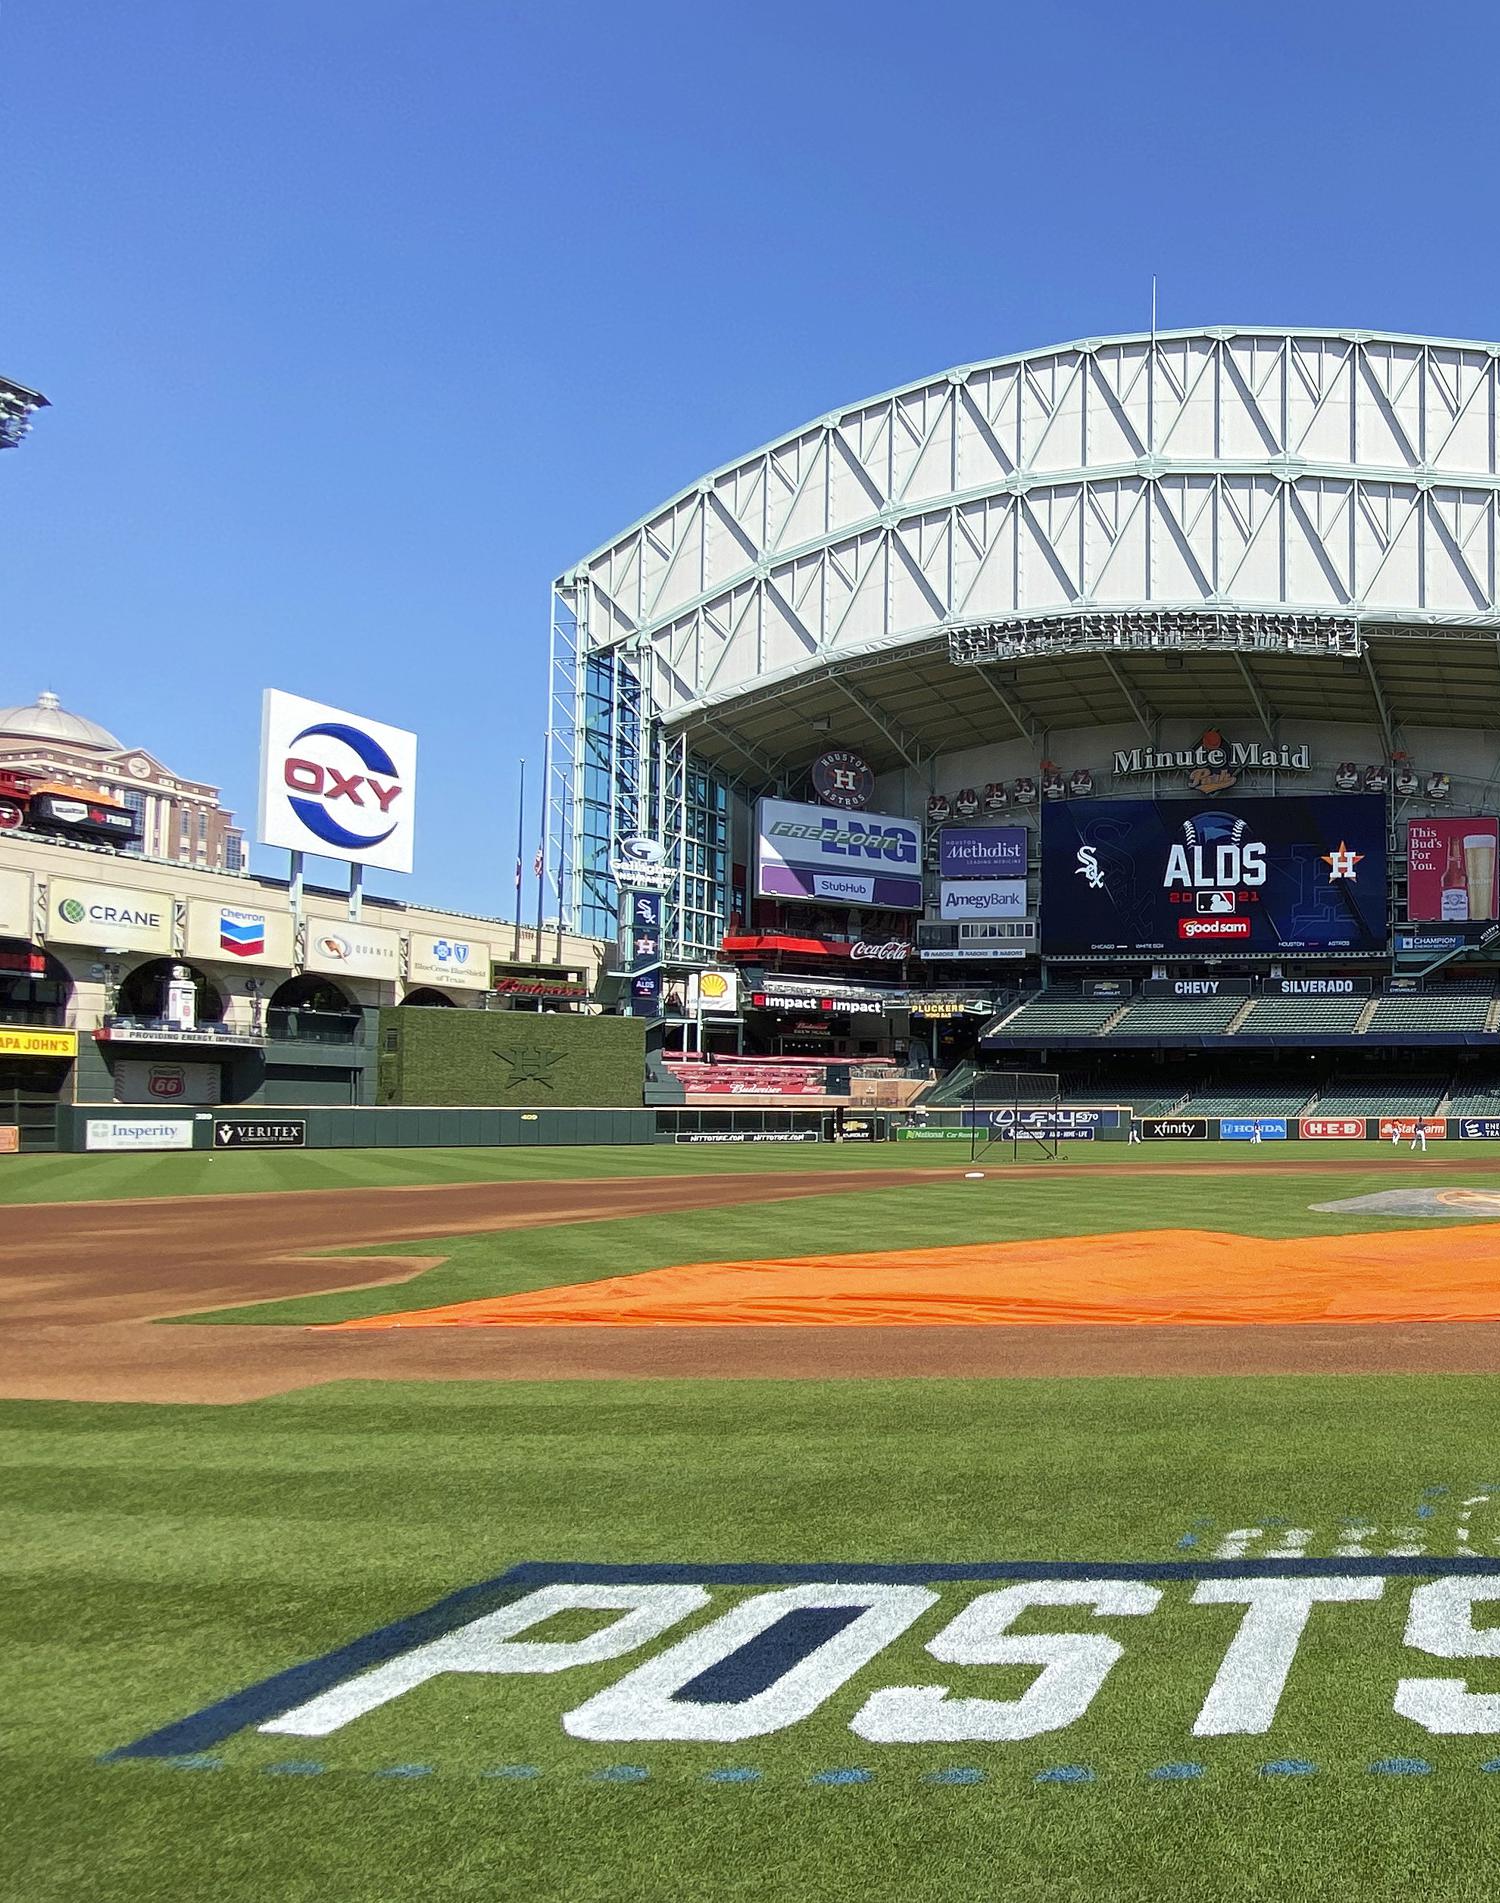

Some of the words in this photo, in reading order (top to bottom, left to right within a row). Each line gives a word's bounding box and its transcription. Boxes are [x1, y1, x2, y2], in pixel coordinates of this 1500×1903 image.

[821, 753, 868, 773] HOUSTON
[1113, 746, 1224, 773] Minute
[1231, 743, 1311, 769] Maid
[284, 757, 402, 812] OXY
[834, 769, 856, 791] H
[823, 789, 865, 805] ASTROS
[773, 823, 898, 849] FREEPORT
[1410, 828, 1437, 838] This
[822, 818, 917, 864] LNG
[1411, 839, 1442, 849] Bud's
[946, 842, 1021, 858] Methodist
[1411, 850, 1430, 860] For
[1163, 842, 1266, 887] ALDS
[1329, 852, 1356, 878] H
[1410, 861, 1436, 871] You.
[821, 880, 866, 894] StubHub
[945, 892, 1019, 908] AmegyBank
[1170, 892, 1193, 902] 20
[1238, 891, 1259, 902] 21
[89, 905, 160, 927] CRANE
[220, 908, 265, 922] Chevron
[355, 945, 394, 958] QUANTA
[414, 962, 449, 974] BlueCross
[450, 965, 486, 977] BlueShield
[435, 975, 445, 983] of
[445, 976, 465, 985] Texas
[1281, 980, 1354, 993] SILVERADO
[1174, 981, 1219, 994] CHEVY
[765, 993, 817, 1010] impact
[832, 999, 881, 1014] impact
[911, 1004, 965, 1013] PLUCKERS
[129, 1031, 179, 1041] PROVIDING
[181, 1034, 212, 1042] ENERGY
[24, 1039, 69, 1051] JOHN'S
[155, 1080, 178, 1092] 66
[730, 1083, 782, 1094] Budweiser
[112, 1124, 178, 1139] Insperity
[237, 1126, 300, 1137] VERITEX
[914, 1130, 944, 1138] National
[1154, 1121, 1195, 1137] xfinity
[1424, 1124, 1445, 1134] arm
